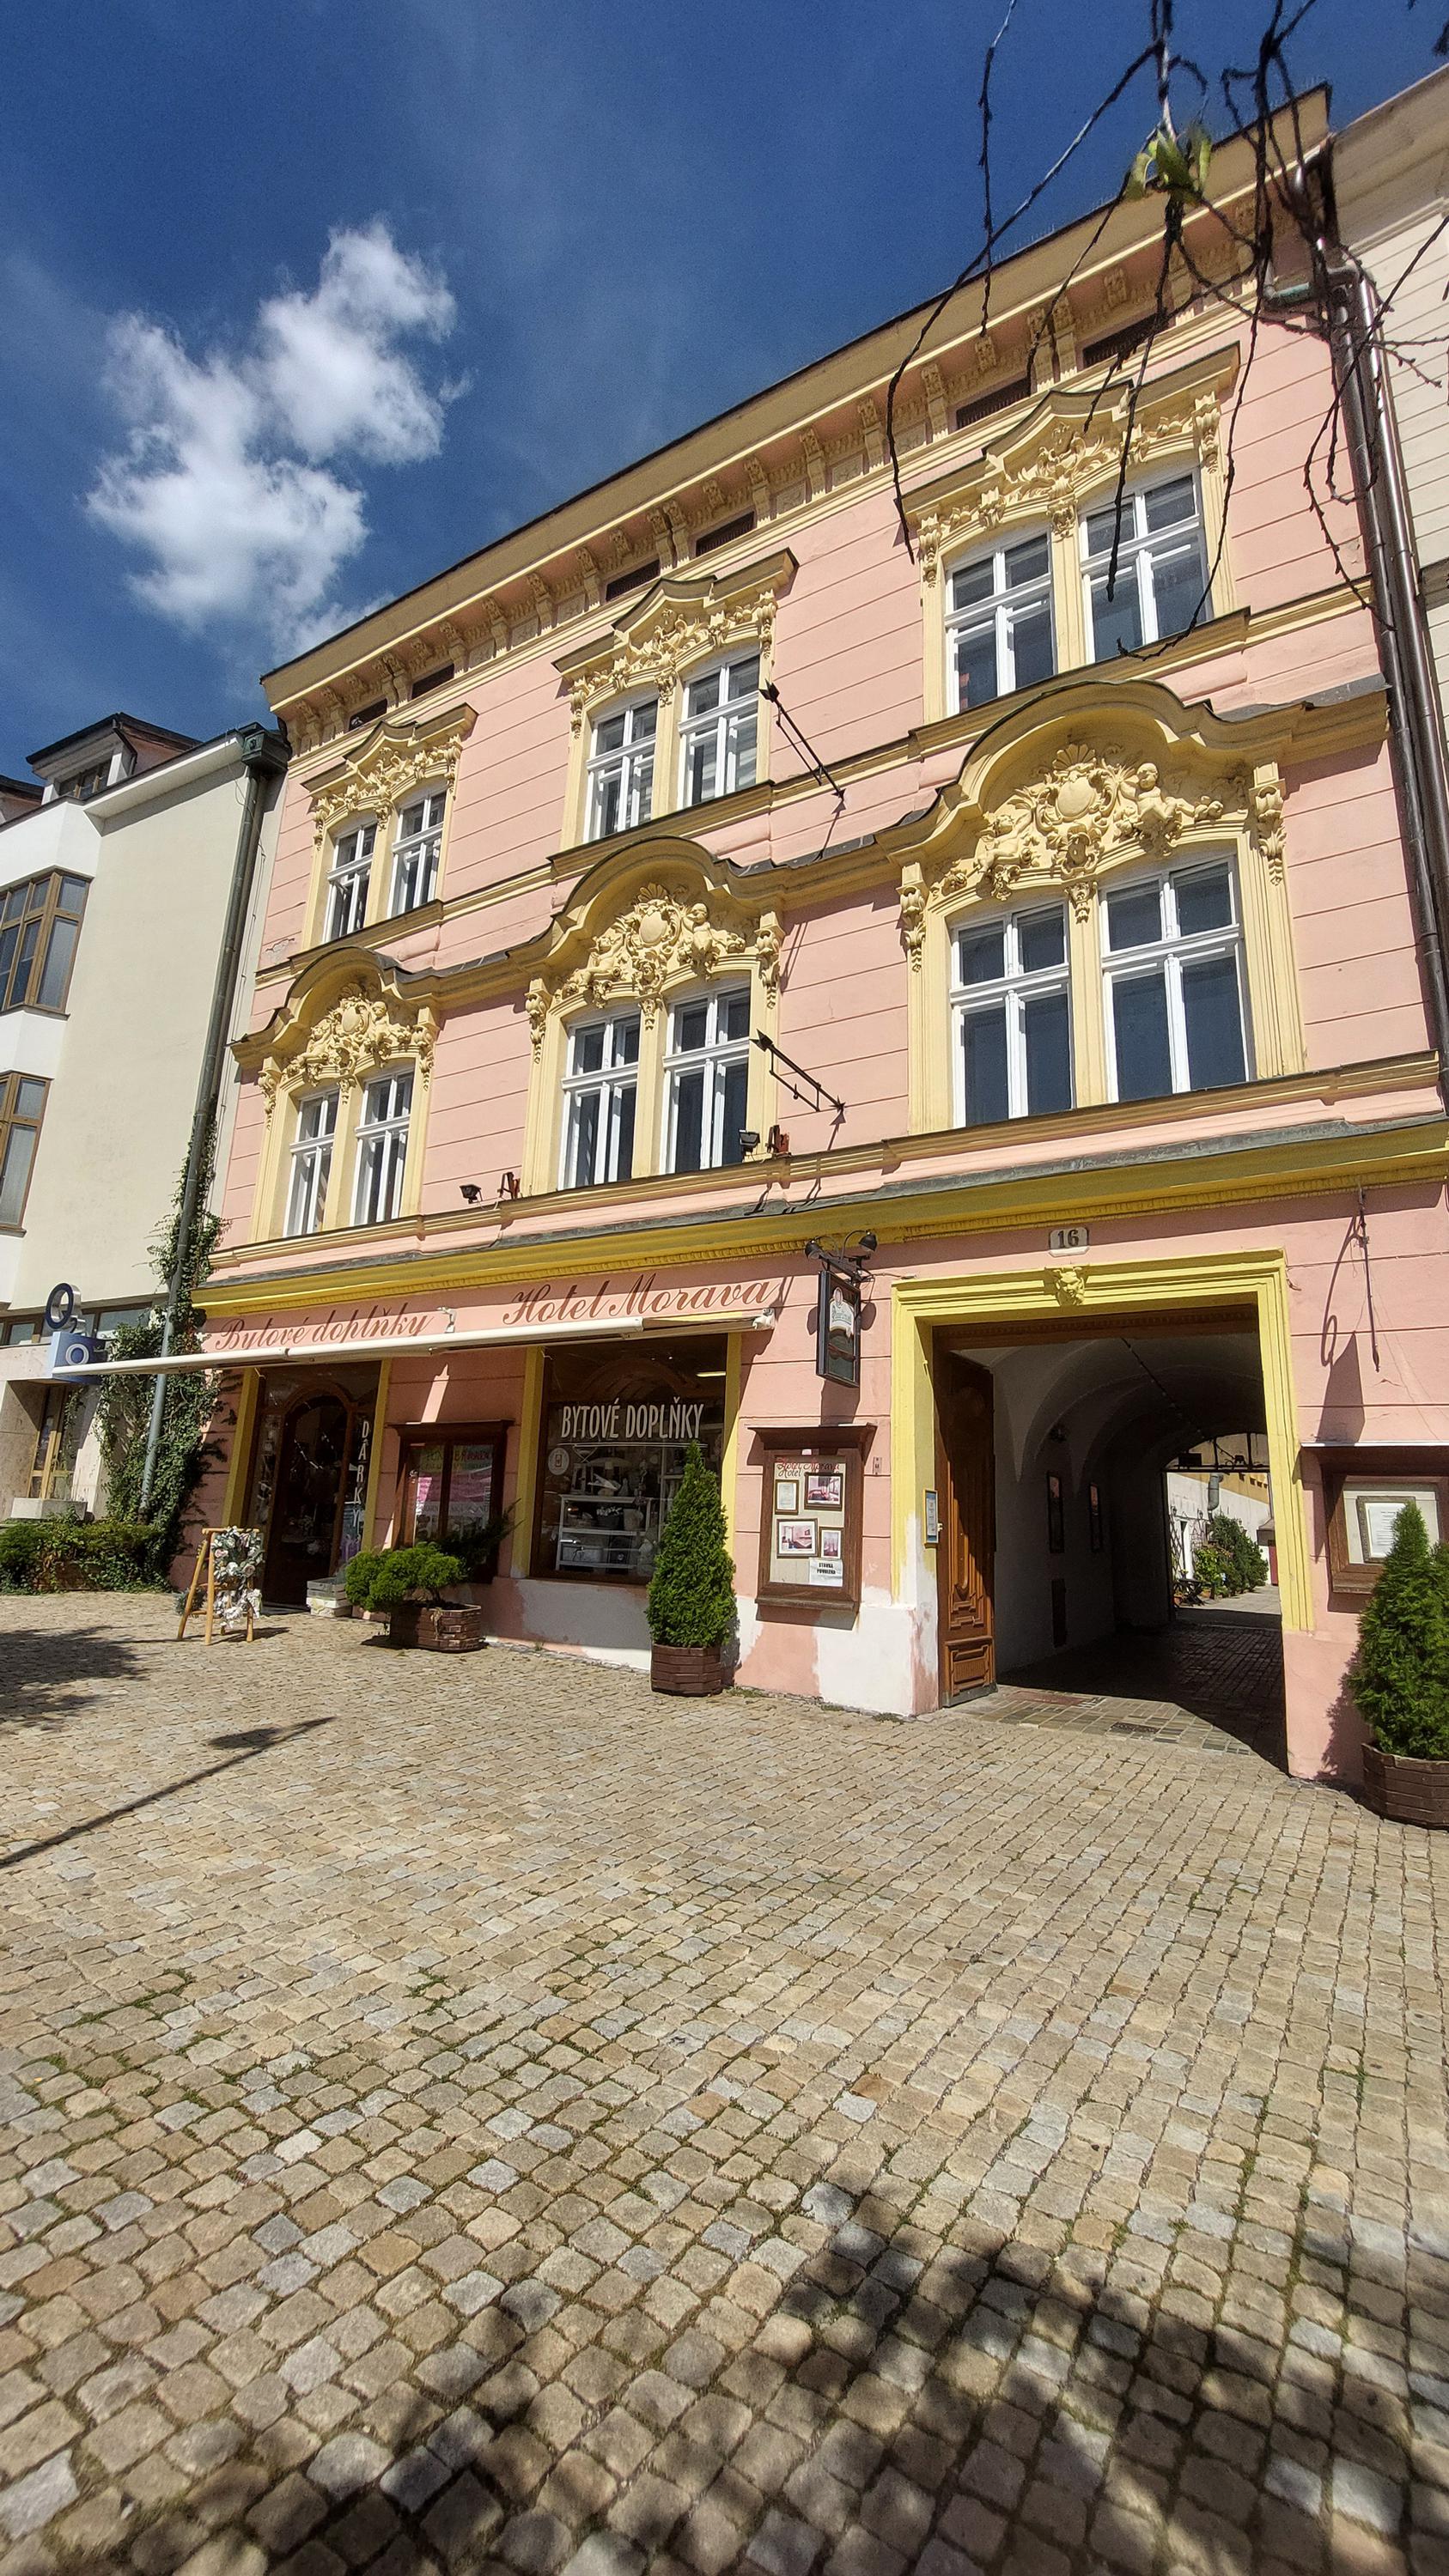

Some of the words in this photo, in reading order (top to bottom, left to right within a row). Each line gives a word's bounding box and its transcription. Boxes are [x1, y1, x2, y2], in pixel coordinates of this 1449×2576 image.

[1057, 1229, 1080, 1249] 16
[502, 1279, 611, 1325] Hotel
[608, 1273, 780, 1316] Morava
[215, 1316, 310, 1350] Bytové
[312, 1302, 434, 1343] doplňky
[561, 1397, 621, 1439] BYTOVÉ
[624, 1396, 705, 1440] DOPLŇKY
[351, 1420, 370, 1528] DÁRKY
